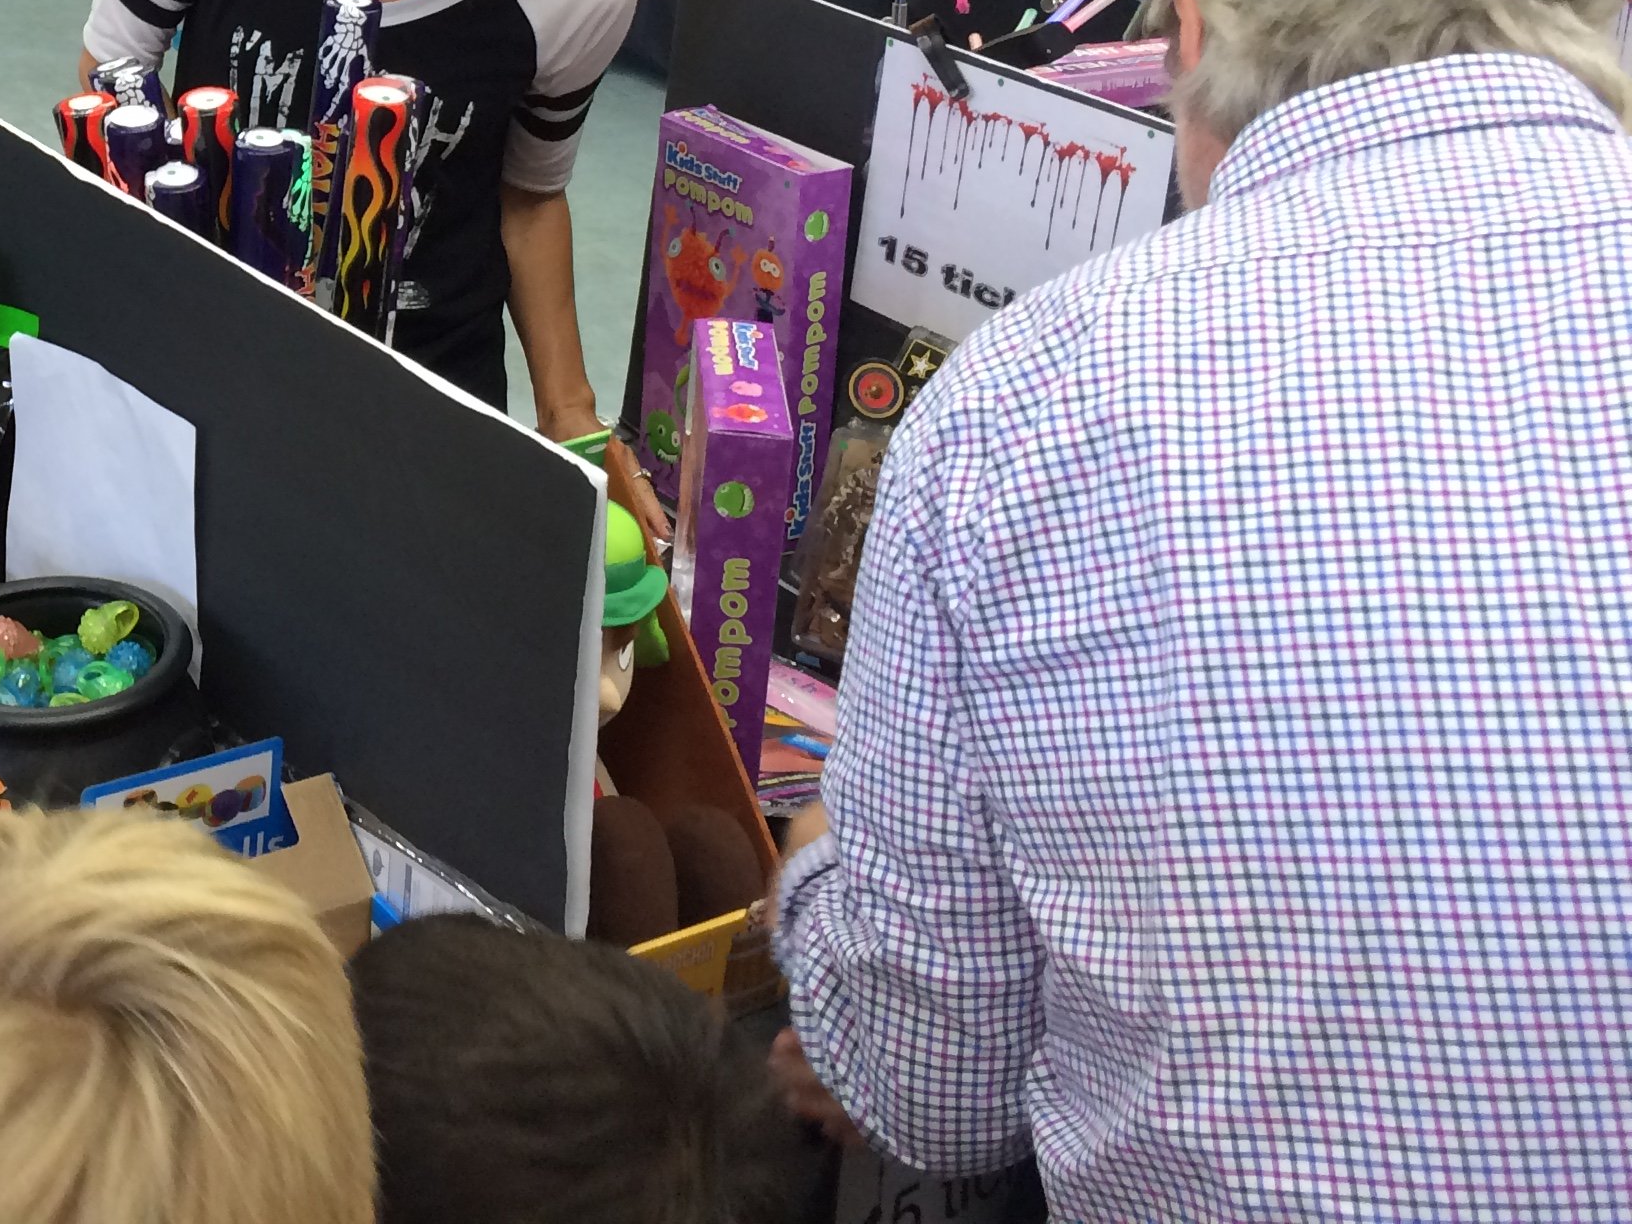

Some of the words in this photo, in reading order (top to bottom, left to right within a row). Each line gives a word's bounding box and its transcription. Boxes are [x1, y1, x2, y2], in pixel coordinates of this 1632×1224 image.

[665, 140, 703, 177] Kids
[703, 162, 743, 194] Stuff
[877, 233, 930, 279] 15
[786, 480, 815, 541] Kids
